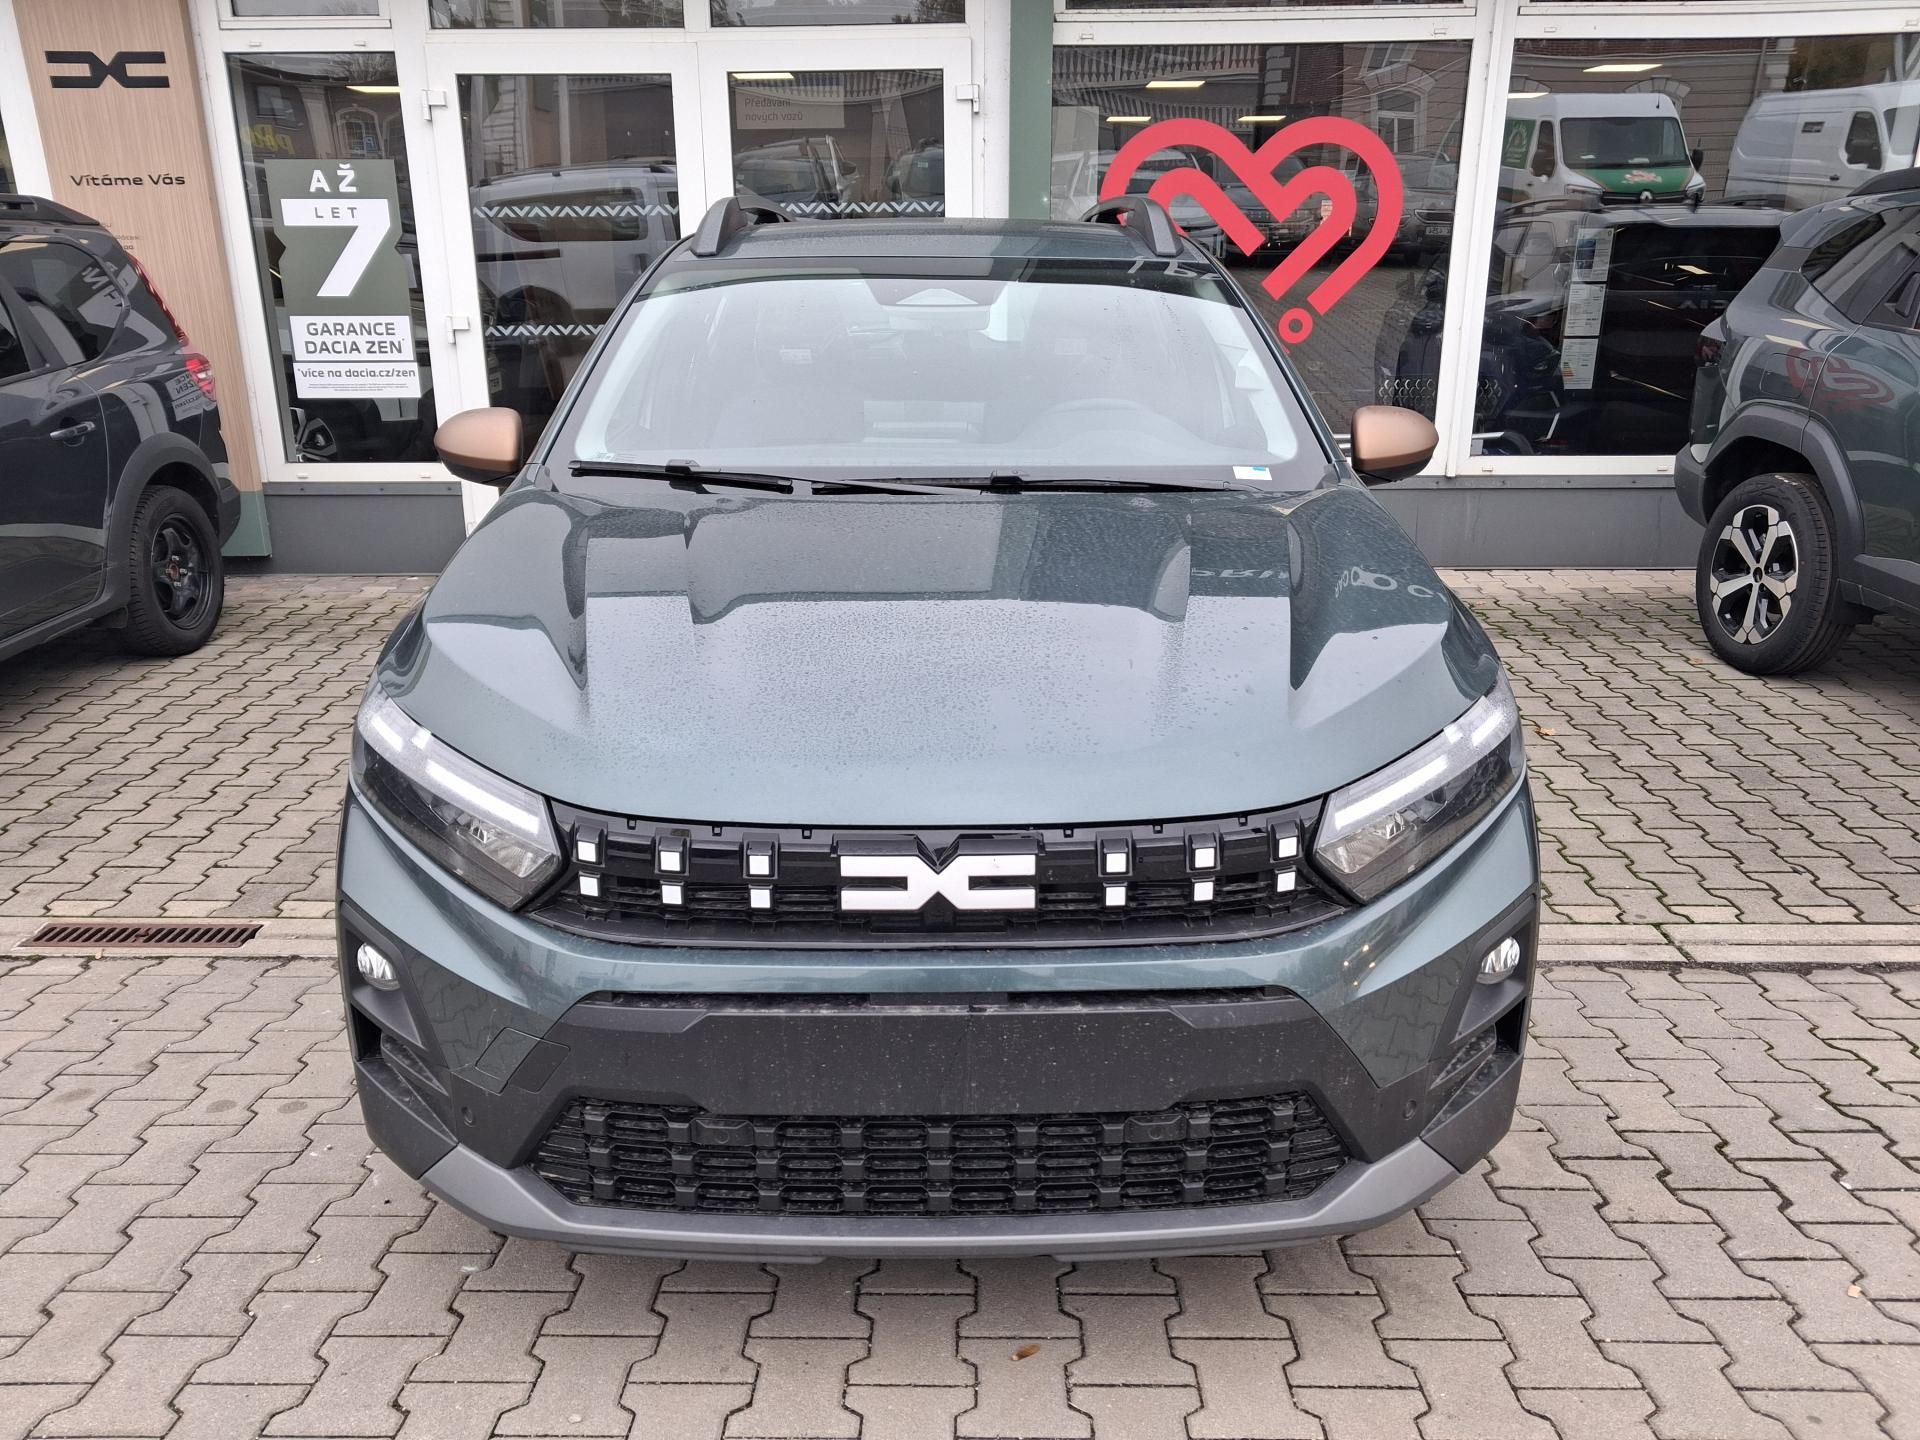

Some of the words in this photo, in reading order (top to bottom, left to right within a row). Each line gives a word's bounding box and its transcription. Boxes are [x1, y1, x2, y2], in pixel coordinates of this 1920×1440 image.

[745, 111, 779, 123] nových
[781, 111, 804, 121] vozů
[70, 174, 144, 187] Vítáme
[147, 173, 186, 186] Vás
[309, 163, 357, 193] AŽ
[314, 206, 358, 219] LET
[280, 198, 391, 297] 7
[306, 322, 396, 336] GARANCE
[304, 340, 361, 354] DACIA
[327, 369, 342, 378] na
[344, 367, 416, 378] dacia.cz/zen
